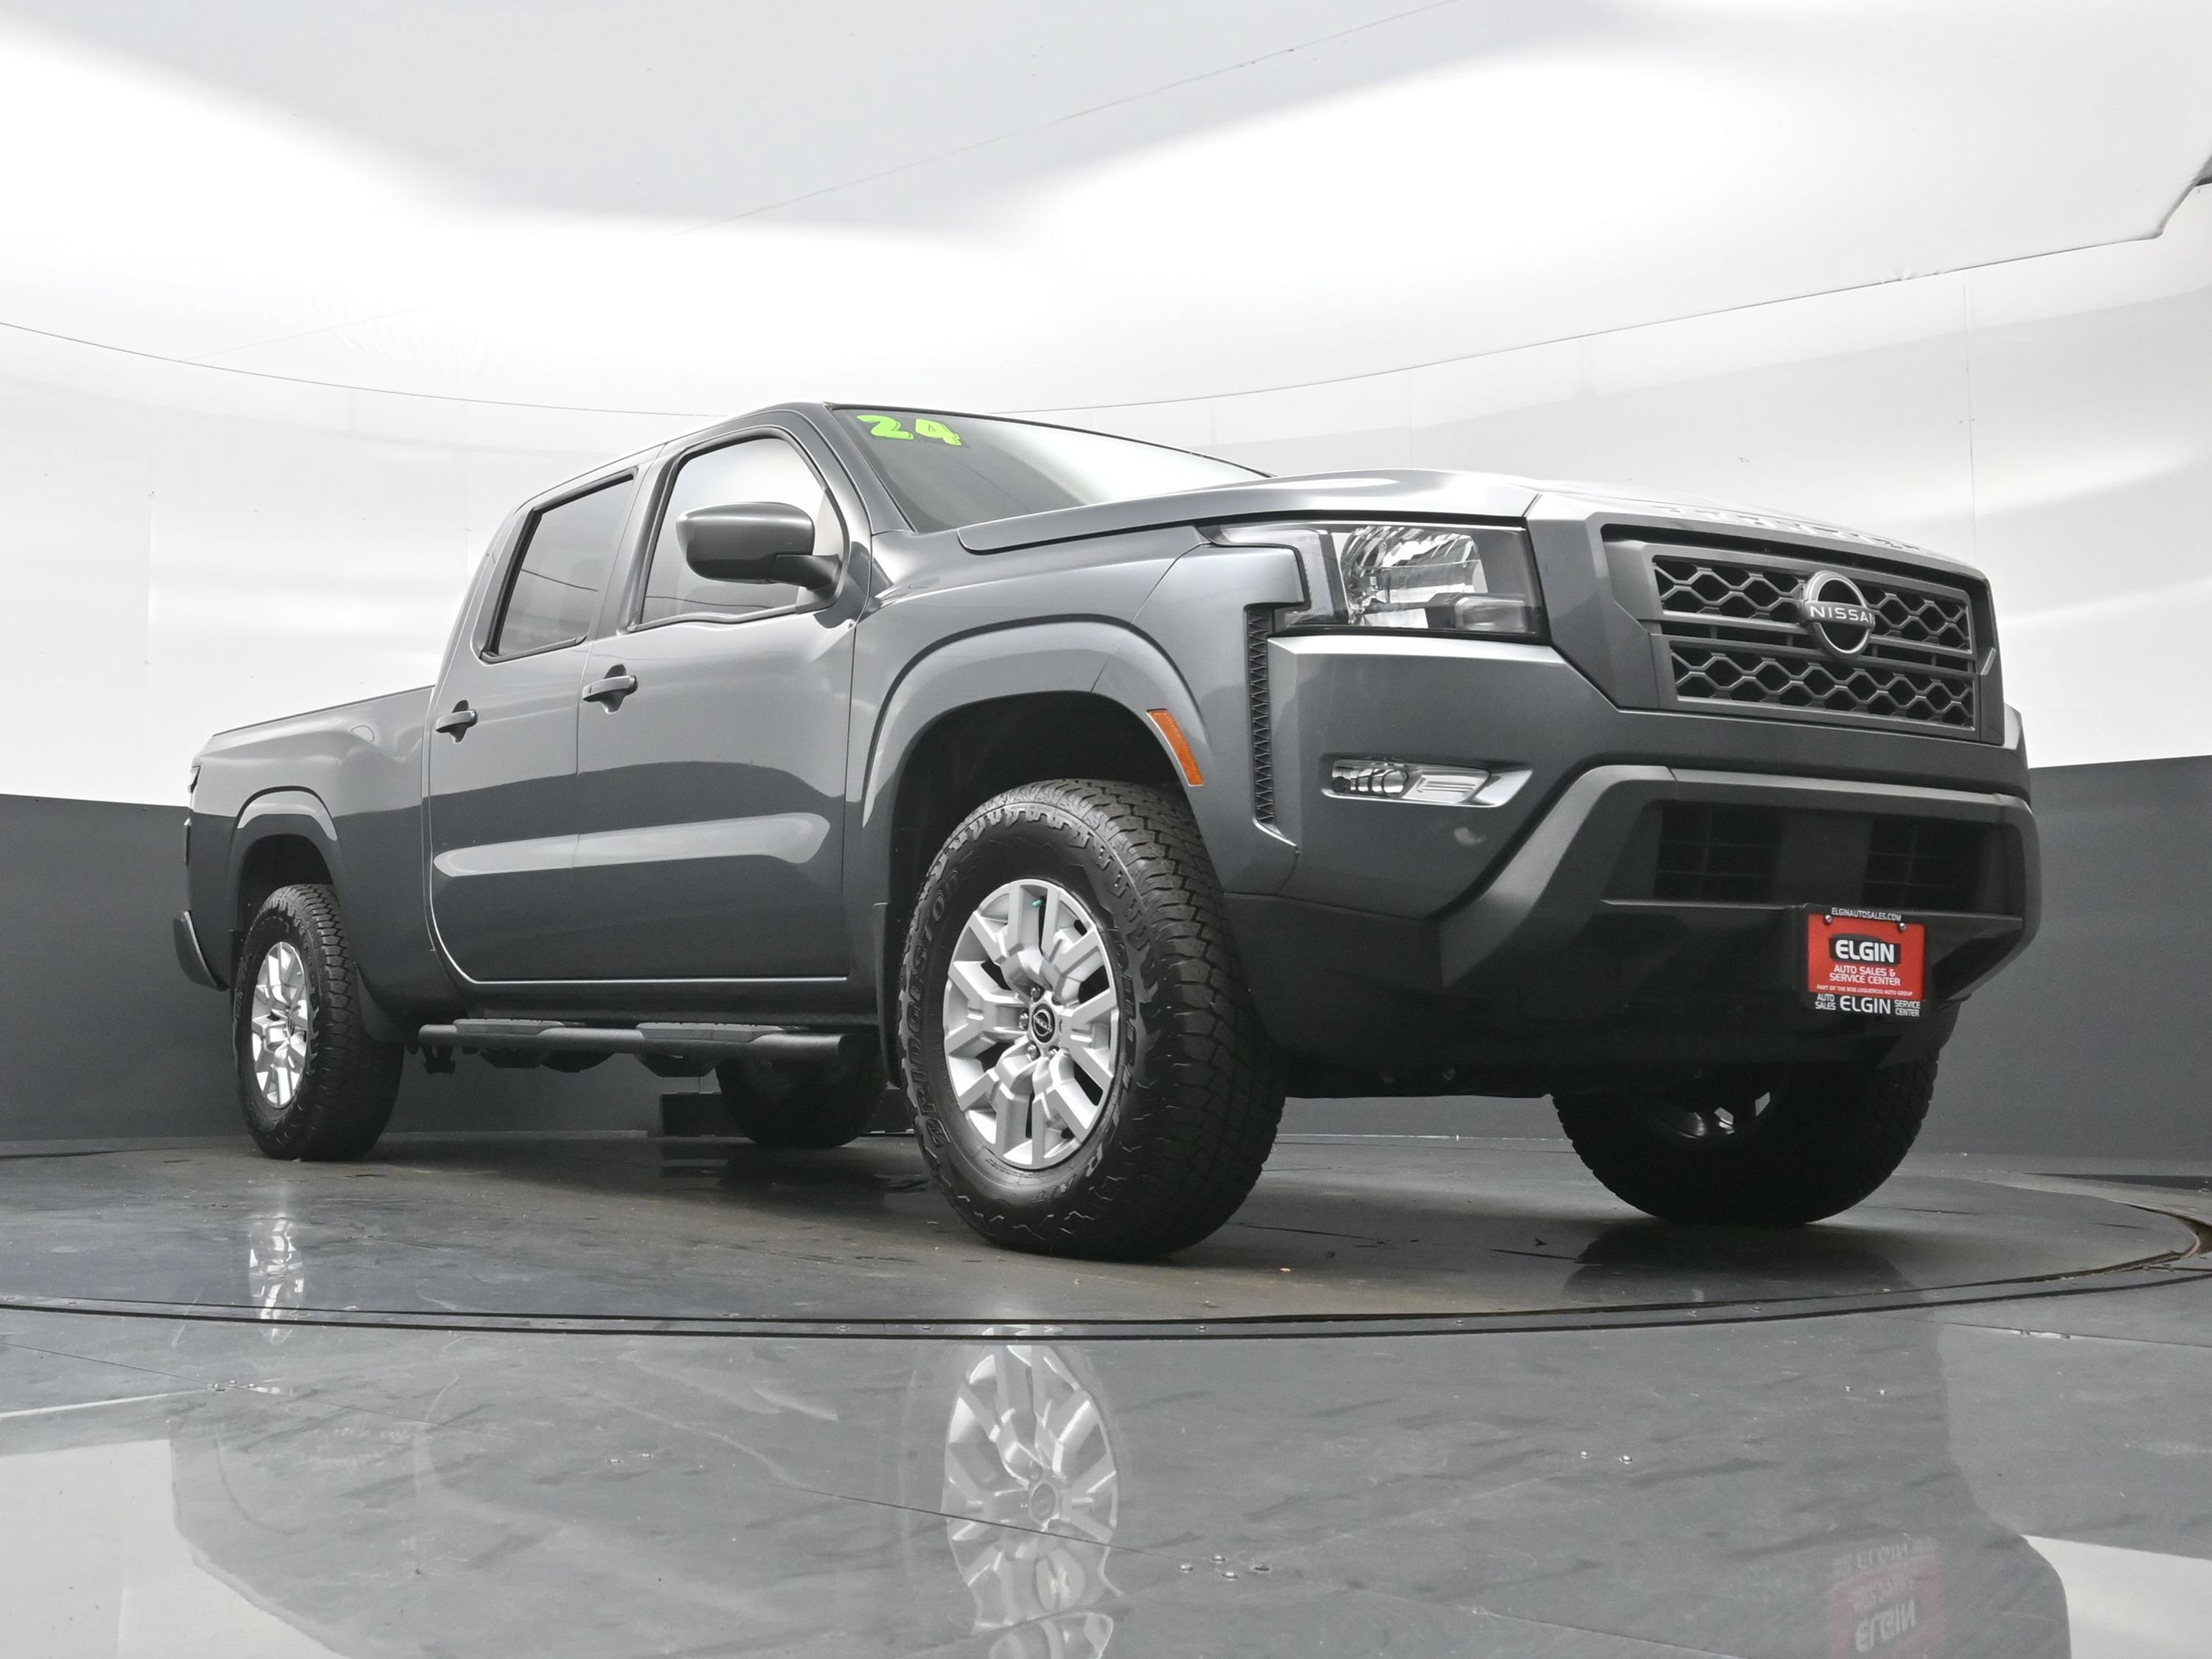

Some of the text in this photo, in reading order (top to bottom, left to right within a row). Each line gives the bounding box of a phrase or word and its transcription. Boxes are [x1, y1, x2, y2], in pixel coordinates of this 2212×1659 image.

[856, 414, 961, 446] 24
[1810, 605, 1875, 626] NISSAN
[1832, 907, 1902, 922] ELGINAUTOSALES.COM
[1835, 939, 1894, 963] ELGIN
[1834, 964, 1896, 977] AUTO SALES &
[1829, 973, 1901, 986] SERVICE CENTER
[1817, 993, 1835, 1001] AUTO
[1815, 1001, 1836, 1010] SALES
[1840, 995, 1891, 1014] ELGIN
[1894, 1000, 1921, 1009] SERVICE
[1895, 1008, 1920, 1017] CENTER
